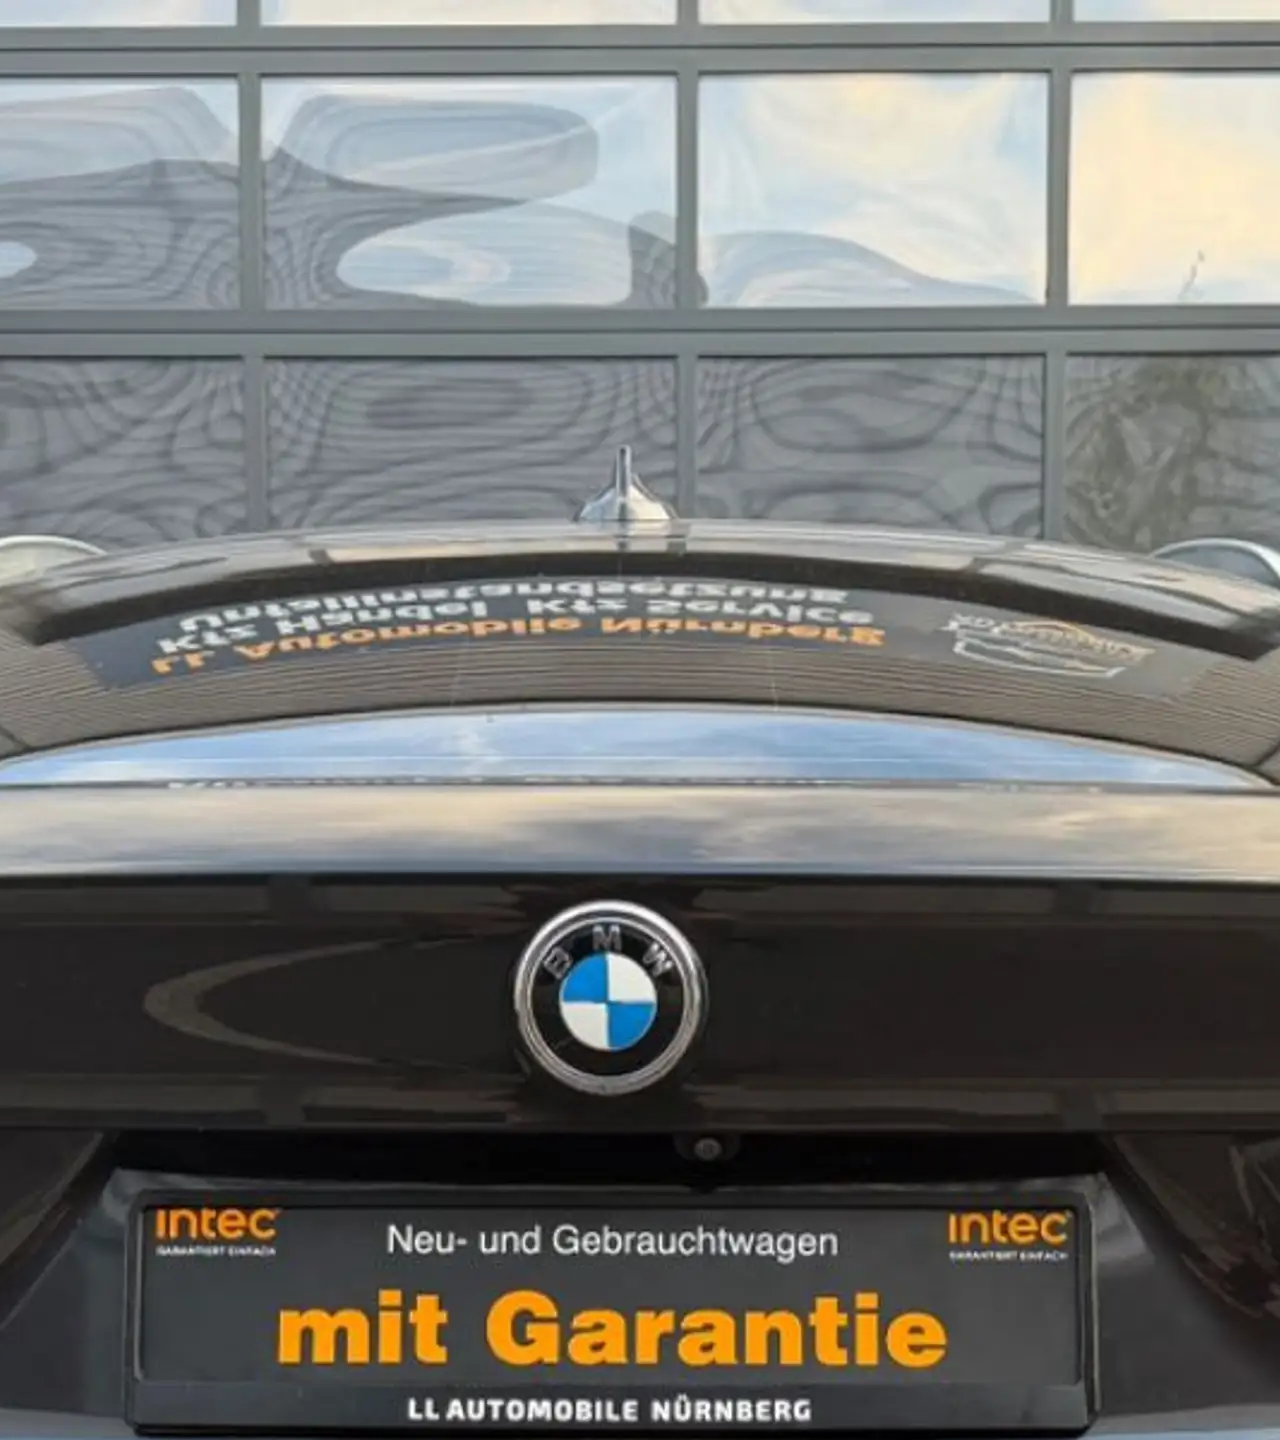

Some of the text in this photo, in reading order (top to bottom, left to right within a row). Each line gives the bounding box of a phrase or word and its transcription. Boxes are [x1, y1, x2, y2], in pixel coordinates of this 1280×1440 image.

[544, 924, 673, 979] BMW
[387, 1224, 838, 1264] Neu- und Gebrauchtwagen
[277, 1289, 947, 1367] mit Garantie
[408, 1394, 812, 1423] LL AUTOMOBILE NÜRNBERG
